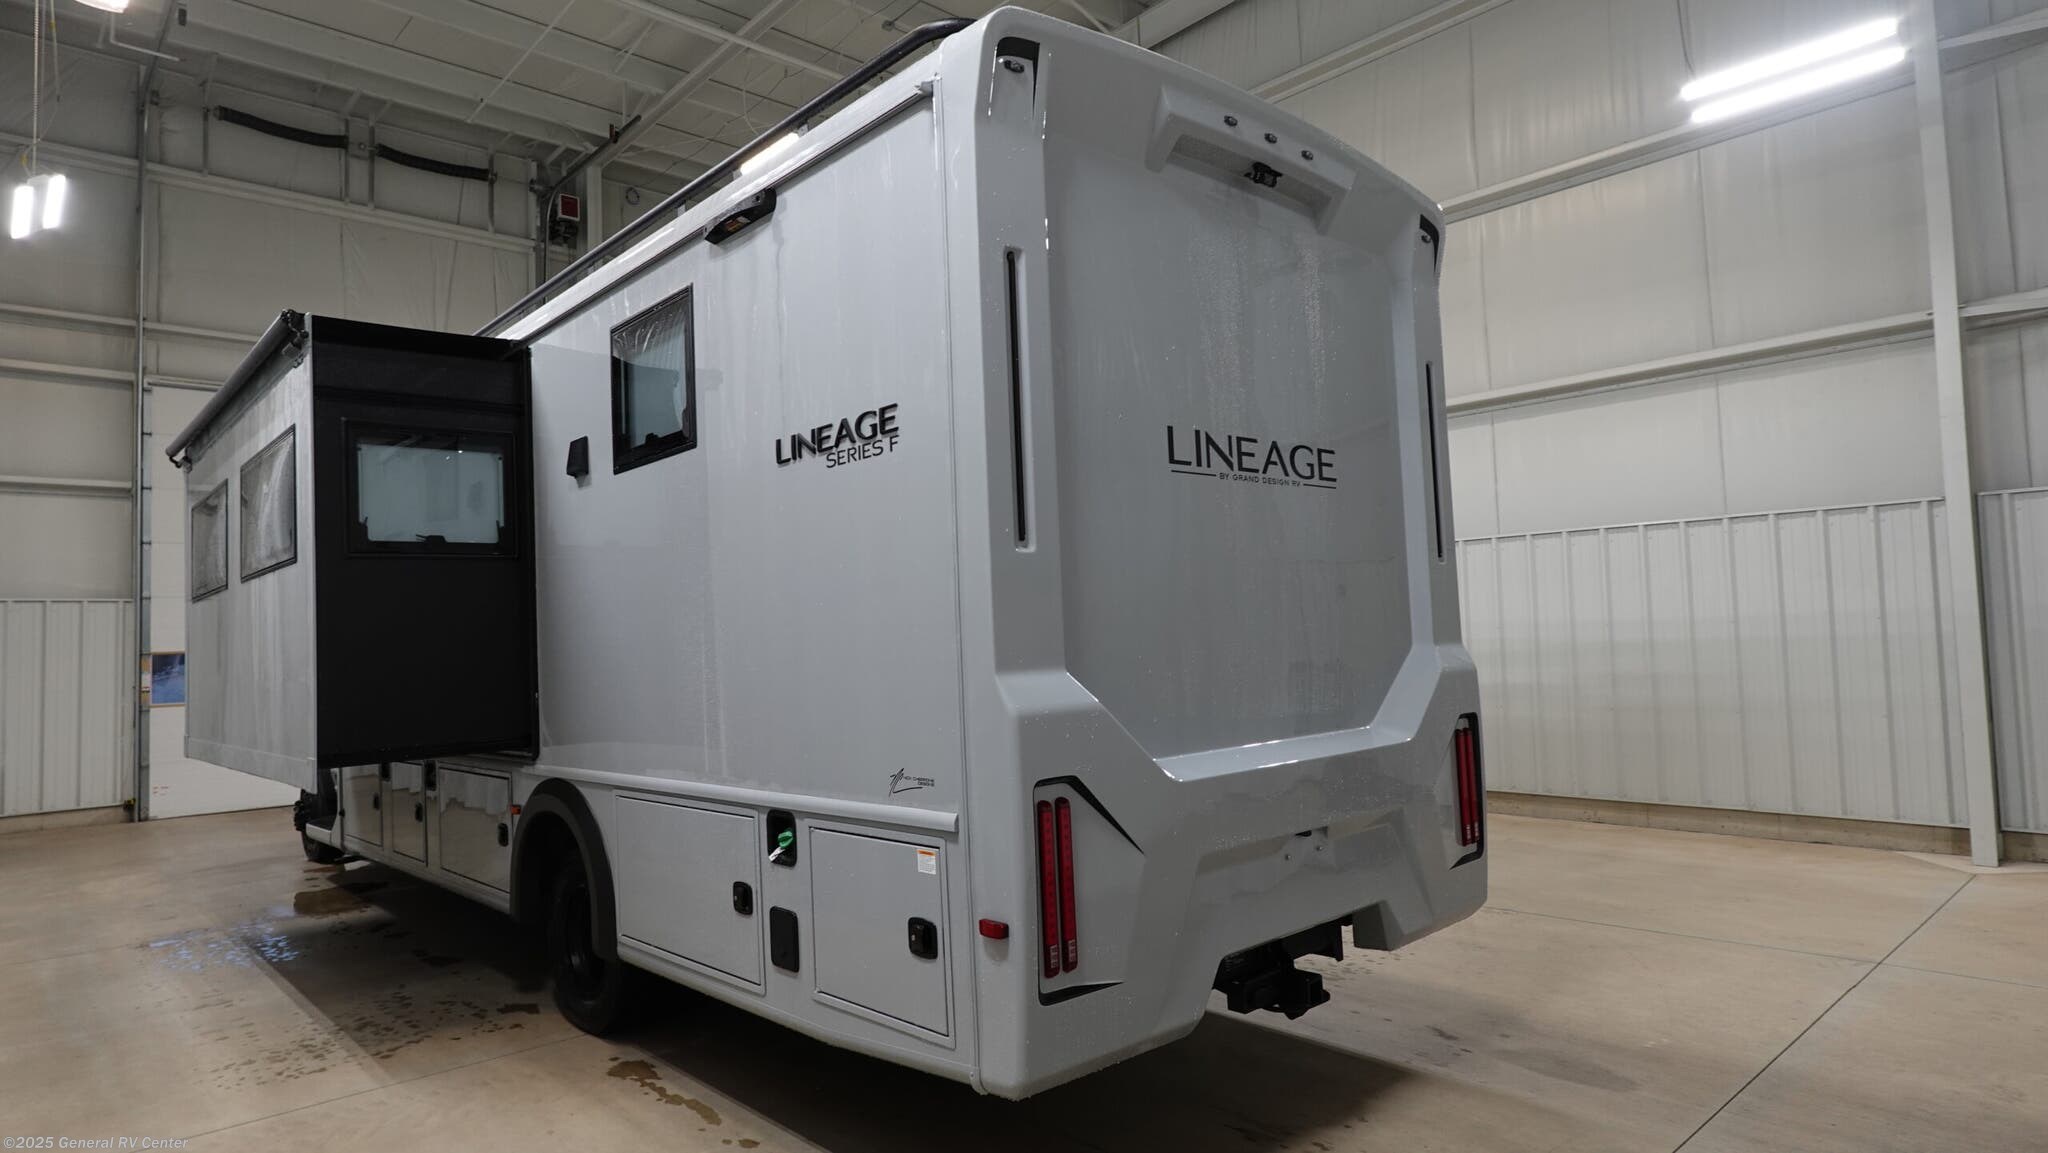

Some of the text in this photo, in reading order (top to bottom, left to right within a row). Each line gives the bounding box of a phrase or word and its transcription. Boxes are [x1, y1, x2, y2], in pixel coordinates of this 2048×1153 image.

[775, 402, 899, 466] LINEAGE
[826, 434, 899, 469] SERIES F
[1167, 425, 1337, 482] LINEAGE
[1219, 472, 1229, 480] BY
[1232, 474, 1259, 483] GRAND
[1262, 477, 1290, 486] DESIGN
